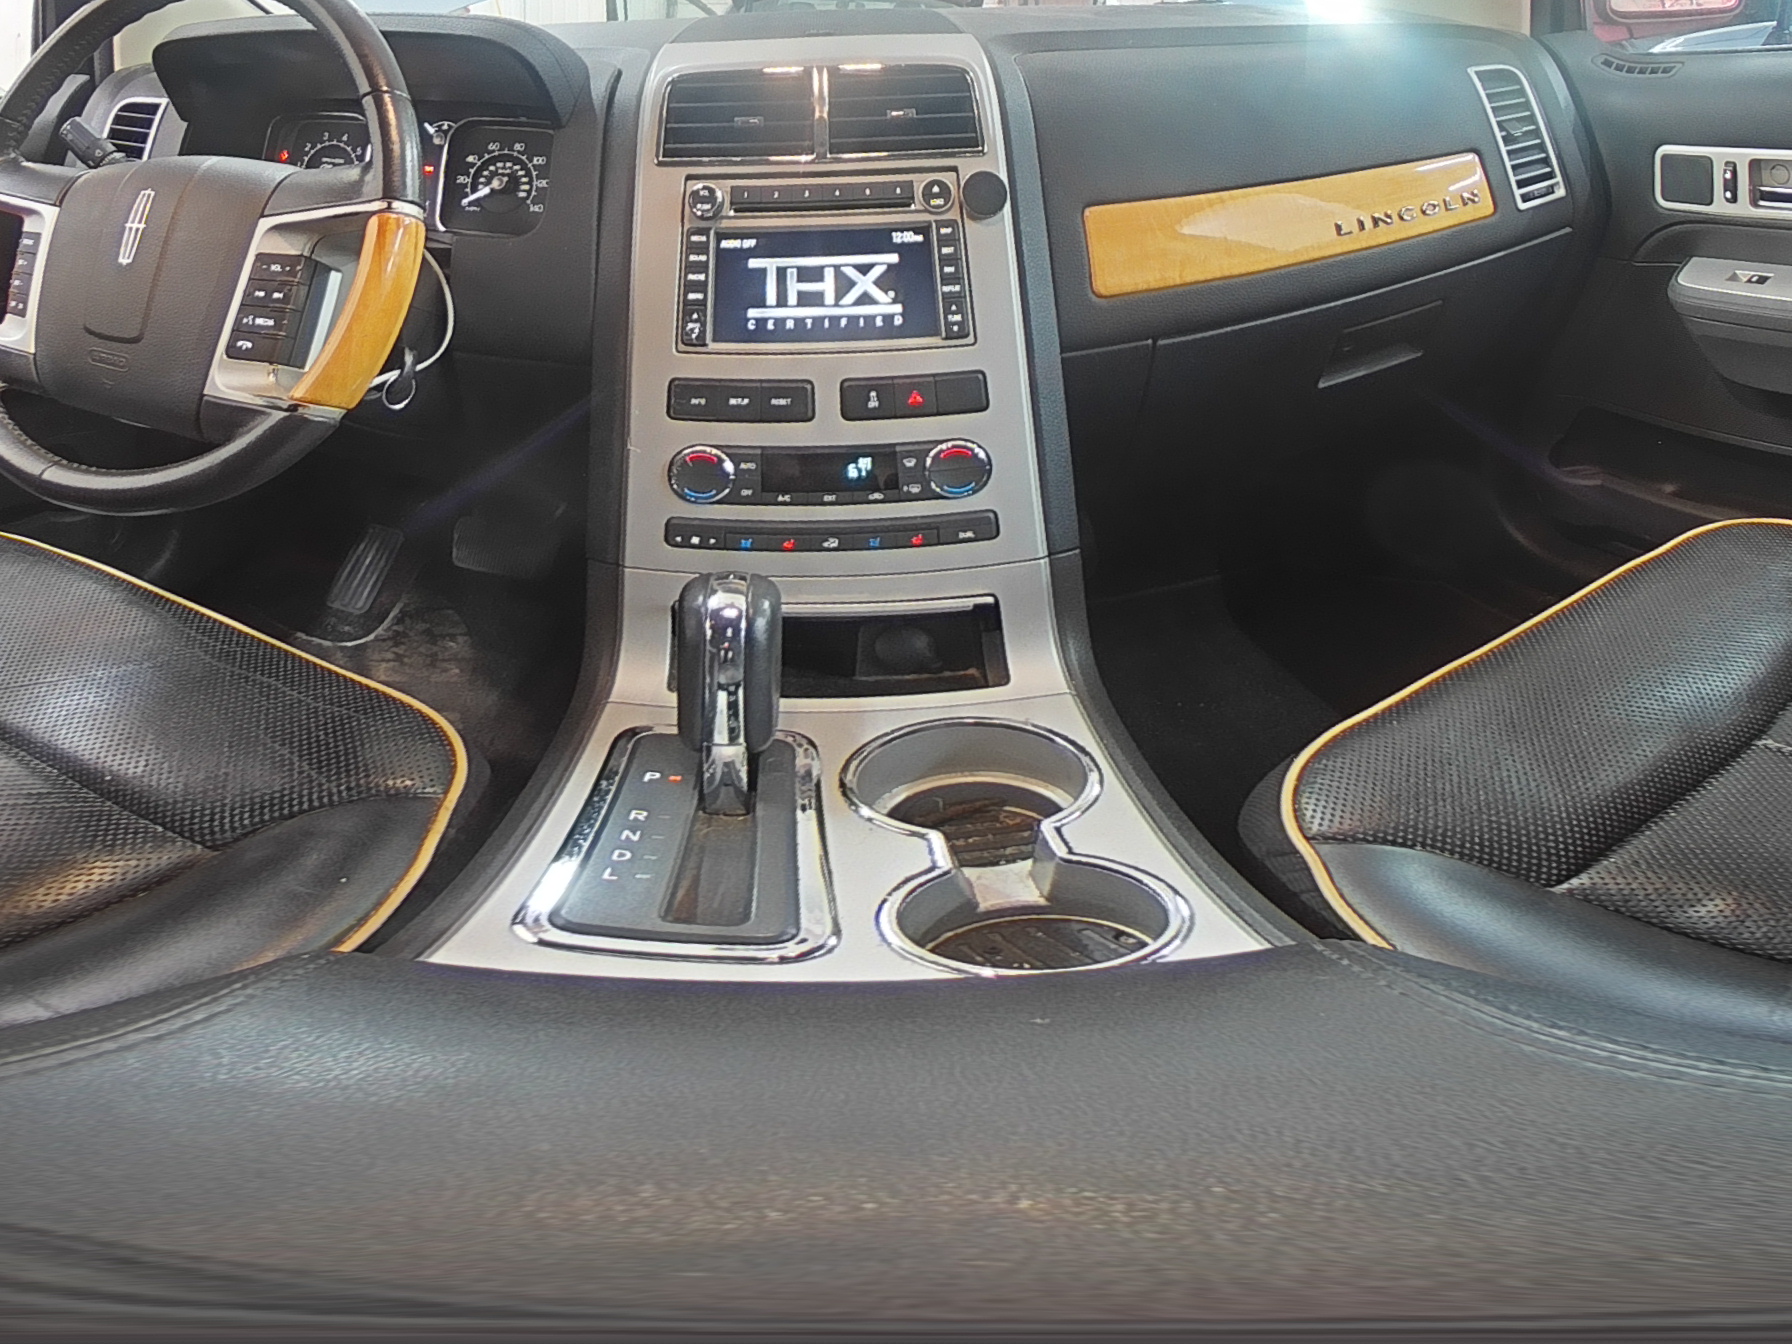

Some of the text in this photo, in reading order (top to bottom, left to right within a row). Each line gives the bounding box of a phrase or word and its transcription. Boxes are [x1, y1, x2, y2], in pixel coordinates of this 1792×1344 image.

[487, 142, 500, 151] 60
[513, 143, 526, 152] 80
[466, 154, 479, 163] 40
[532, 156, 547, 165] 100
[456, 175, 468, 184] 20
[1334, 188, 1481, 237] LINCOLN
[747, 253, 900, 307] THX
[747, 314, 903, 331] CERTIFIED
[642, 771, 661, 783] P
[628, 809, 648, 821] R
[620, 829, 641, 841] N
[611, 849, 632, 861] D
[602, 867, 618, 880] L
